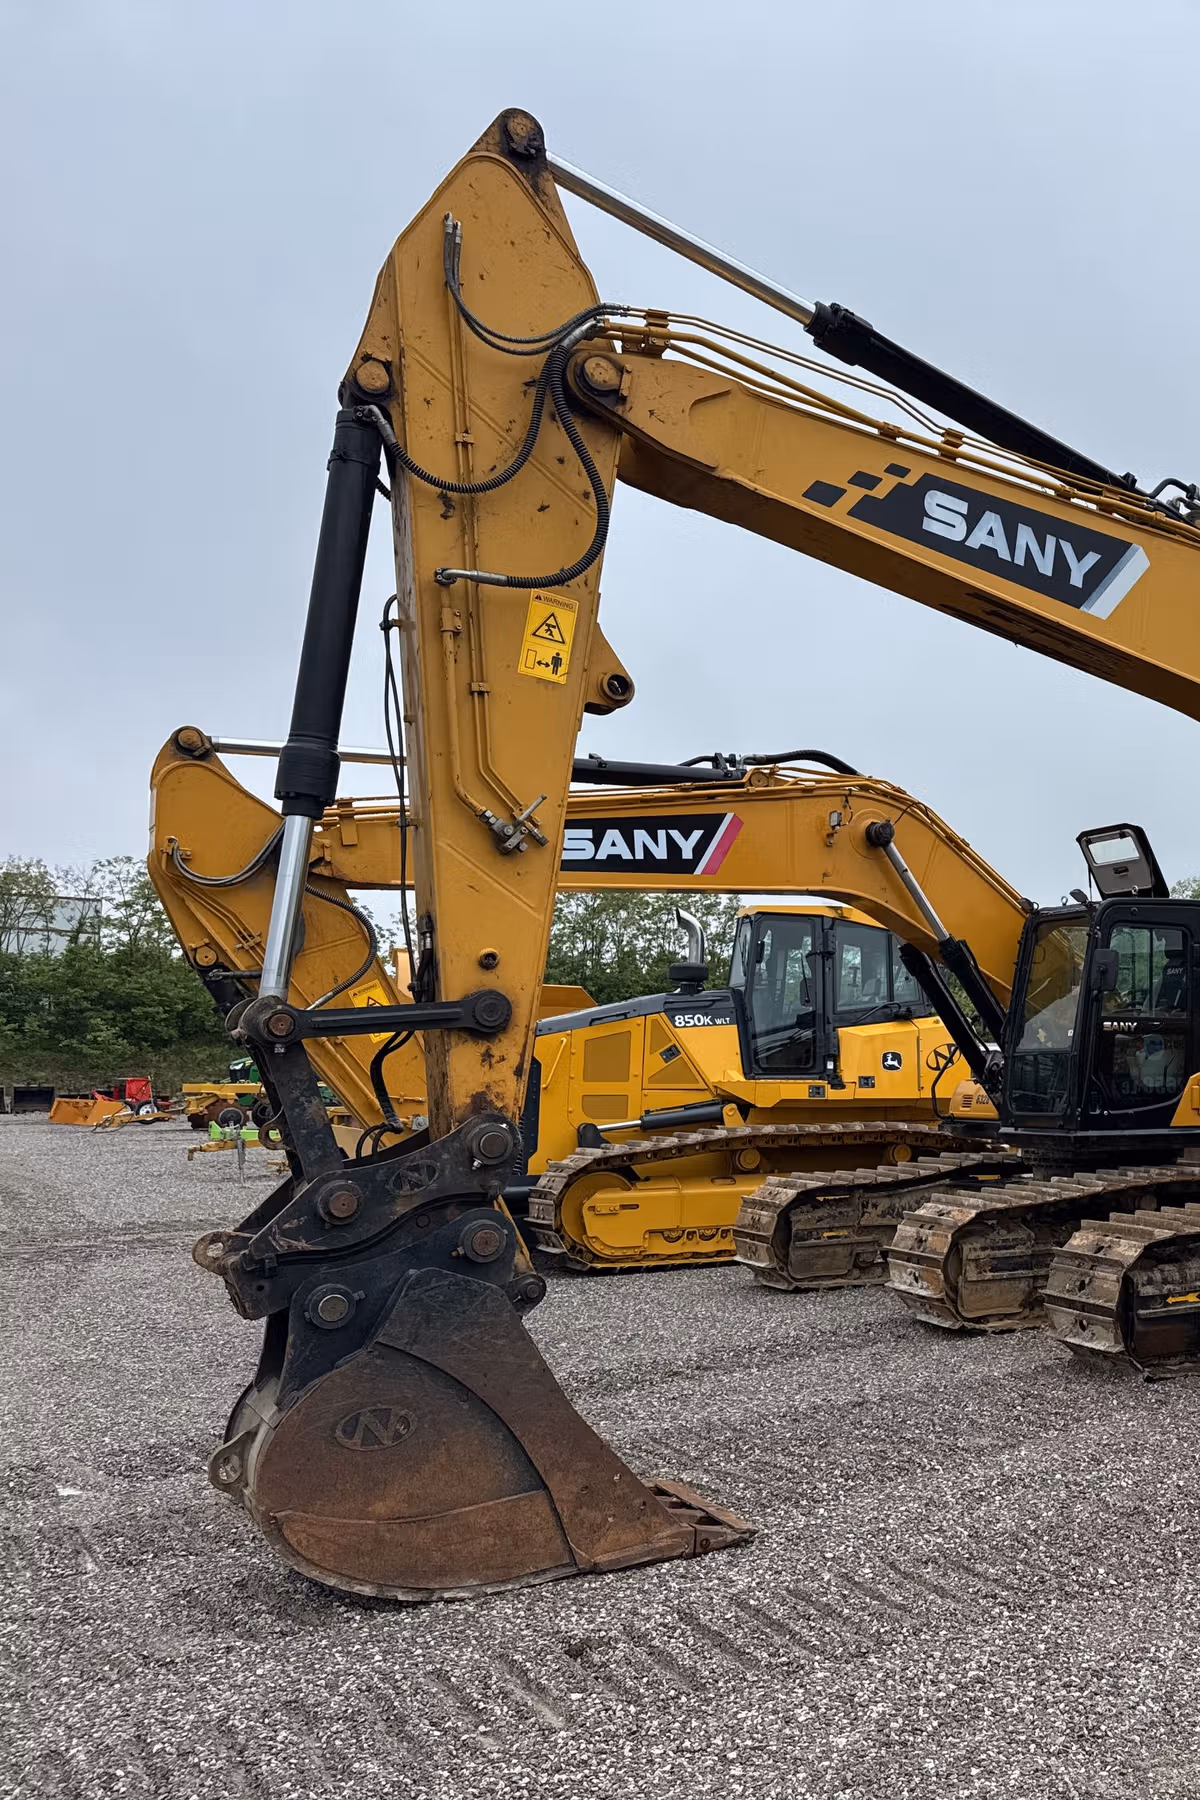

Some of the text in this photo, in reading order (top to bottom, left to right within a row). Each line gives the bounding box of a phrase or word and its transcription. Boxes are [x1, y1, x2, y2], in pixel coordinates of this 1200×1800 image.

[922, 490, 1102, 589] SANY
[543, 595, 574, 610] WARNING
[561, 829, 704, 860] SANY
[1166, 967, 1184, 976] SANY
[674, 1013, 731, 1027] 850K WLT
[1102, 1021, 1138, 1032] SANY
